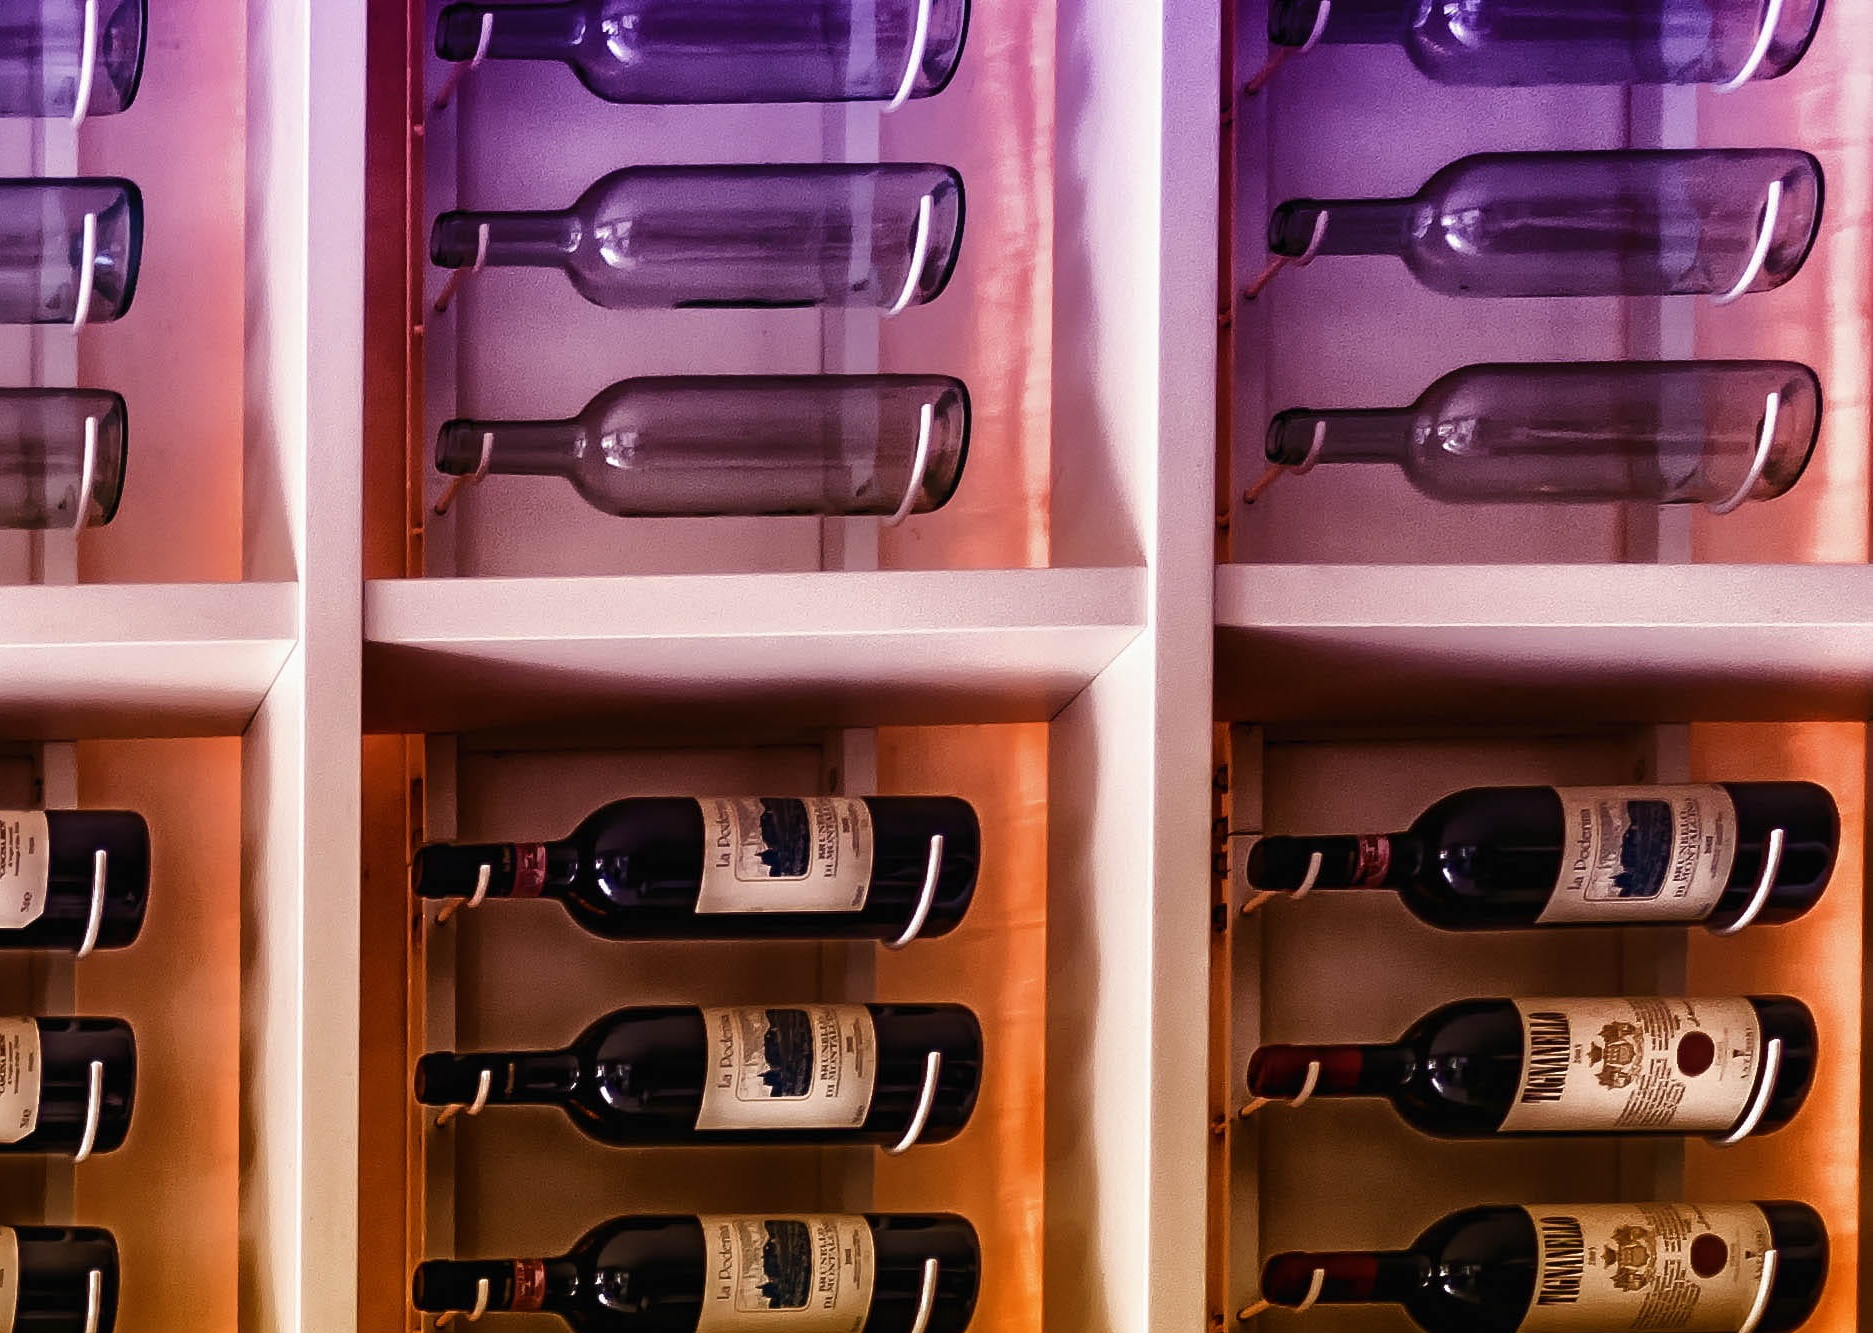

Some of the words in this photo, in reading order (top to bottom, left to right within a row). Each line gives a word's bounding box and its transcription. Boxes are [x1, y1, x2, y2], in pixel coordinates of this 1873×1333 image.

[1567, 876, 1583, 890] La
[1519, 1012, 1571, 1104] TIGNANELLO
[718, 1074, 731, 1088] La
[1536, 1216, 1585, 1306] TIGNANELLO
[716, 1286, 731, 1300] La
